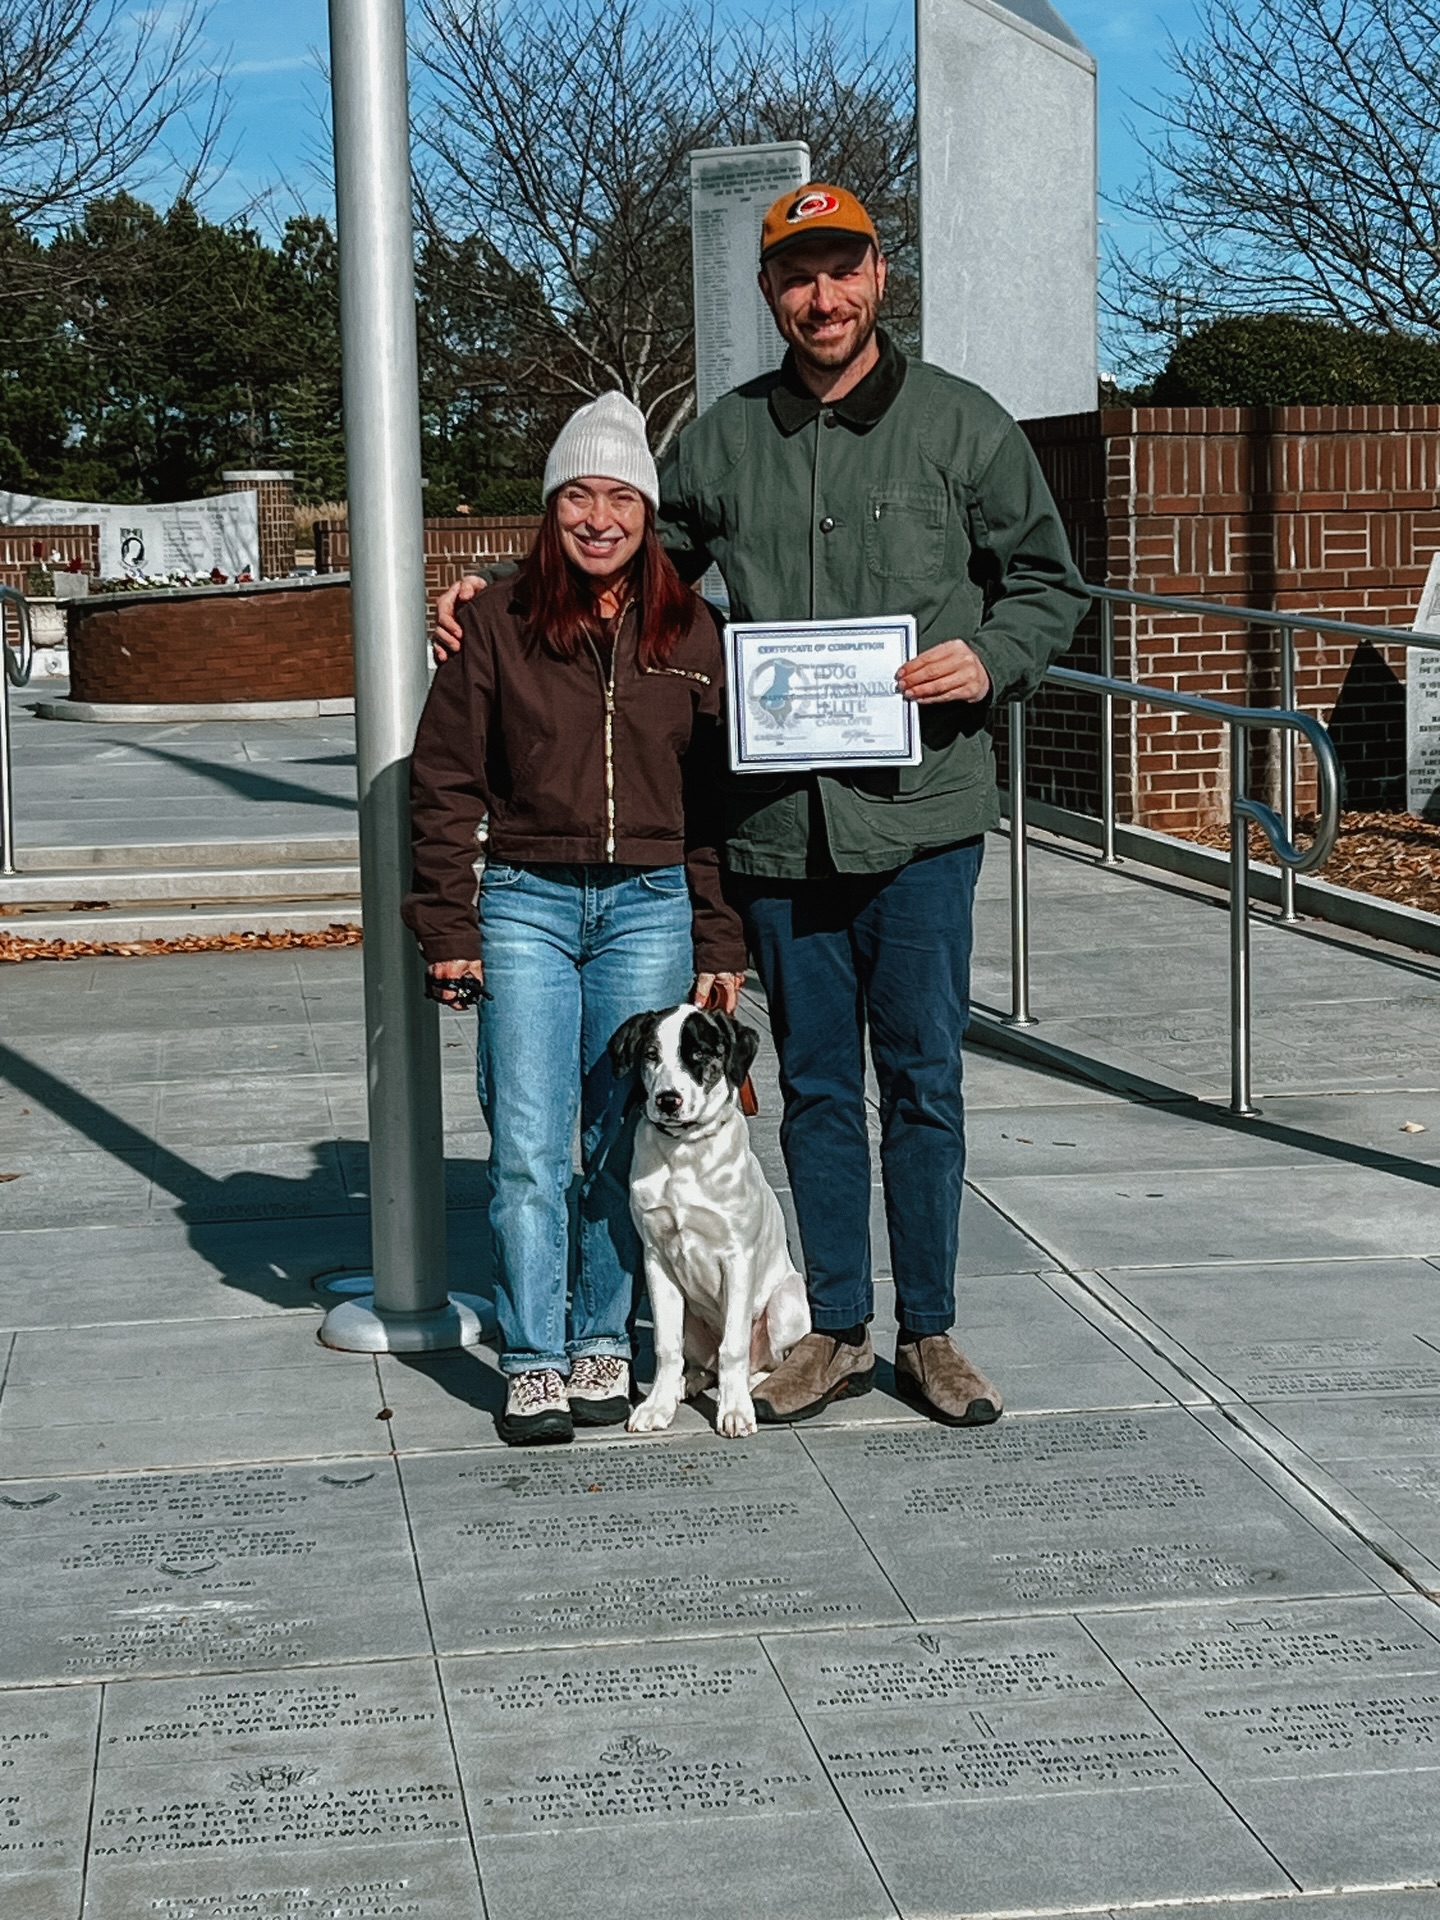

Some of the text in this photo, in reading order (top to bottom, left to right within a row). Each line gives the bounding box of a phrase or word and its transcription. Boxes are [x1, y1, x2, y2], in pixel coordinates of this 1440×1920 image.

[758, 642, 885, 654] CERTIFICATE OF COMPLETION
